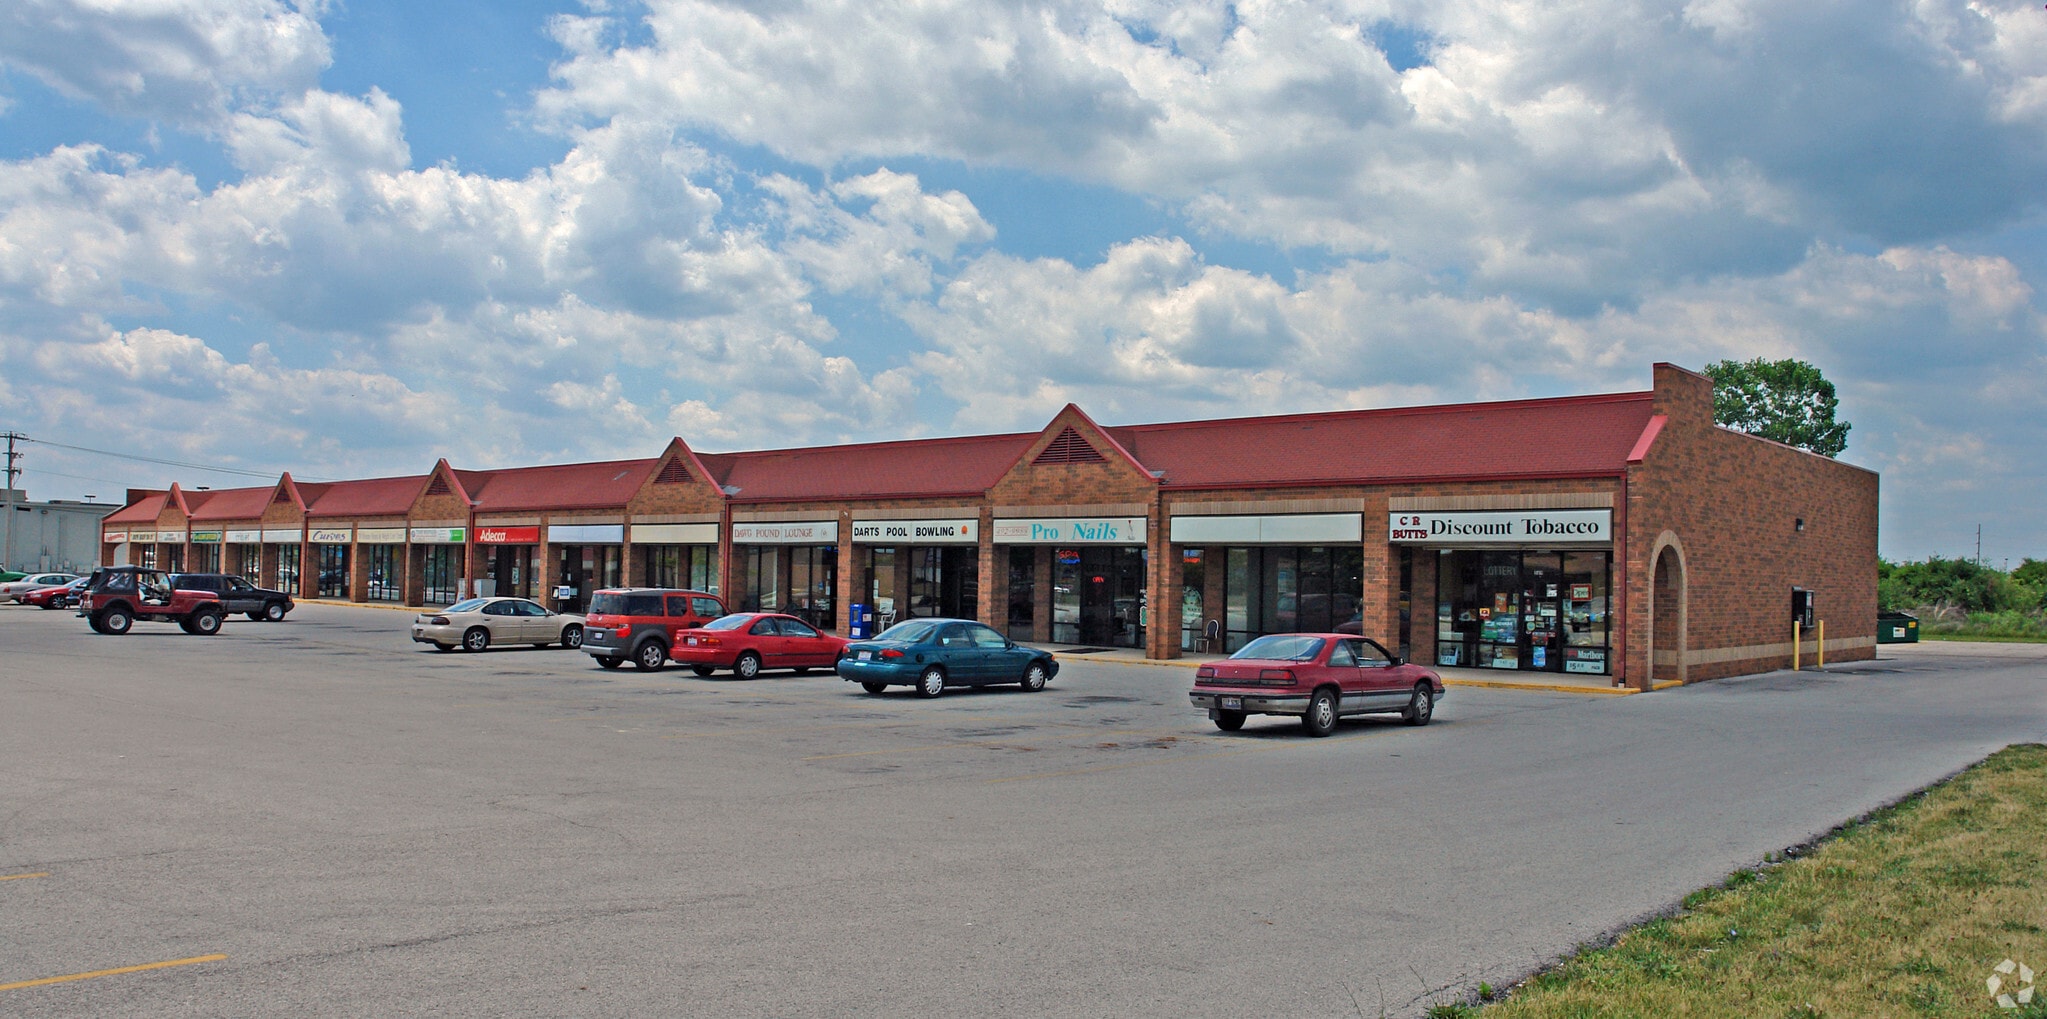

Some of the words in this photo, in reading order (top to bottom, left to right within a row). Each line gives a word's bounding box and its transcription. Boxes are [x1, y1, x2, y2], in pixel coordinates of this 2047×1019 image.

[1399, 516, 1408, 526] C
[1412, 516, 1421, 526] R
[1430, 519, 1513, 535] Discount
[1520, 518, 1599, 535] Tobacco
[312, 530, 346, 542] Curves
[480, 528, 506, 542] Adecco
[755, 528, 780, 538] POUND
[784, 528, 813, 538] LOUNGE
[853, 527, 880, 537] DARTS
[886, 527, 908, 537] POOL
[915, 526, 955, 537] BOWLING
[1031, 523, 1059, 540] Pro
[1071, 523, 1118, 541] Nails
[1392, 529, 1428, 539] BUTTS
[1058, 550, 1079, 559] SPA
[1483, 565, 1517, 576] LOTTERY
